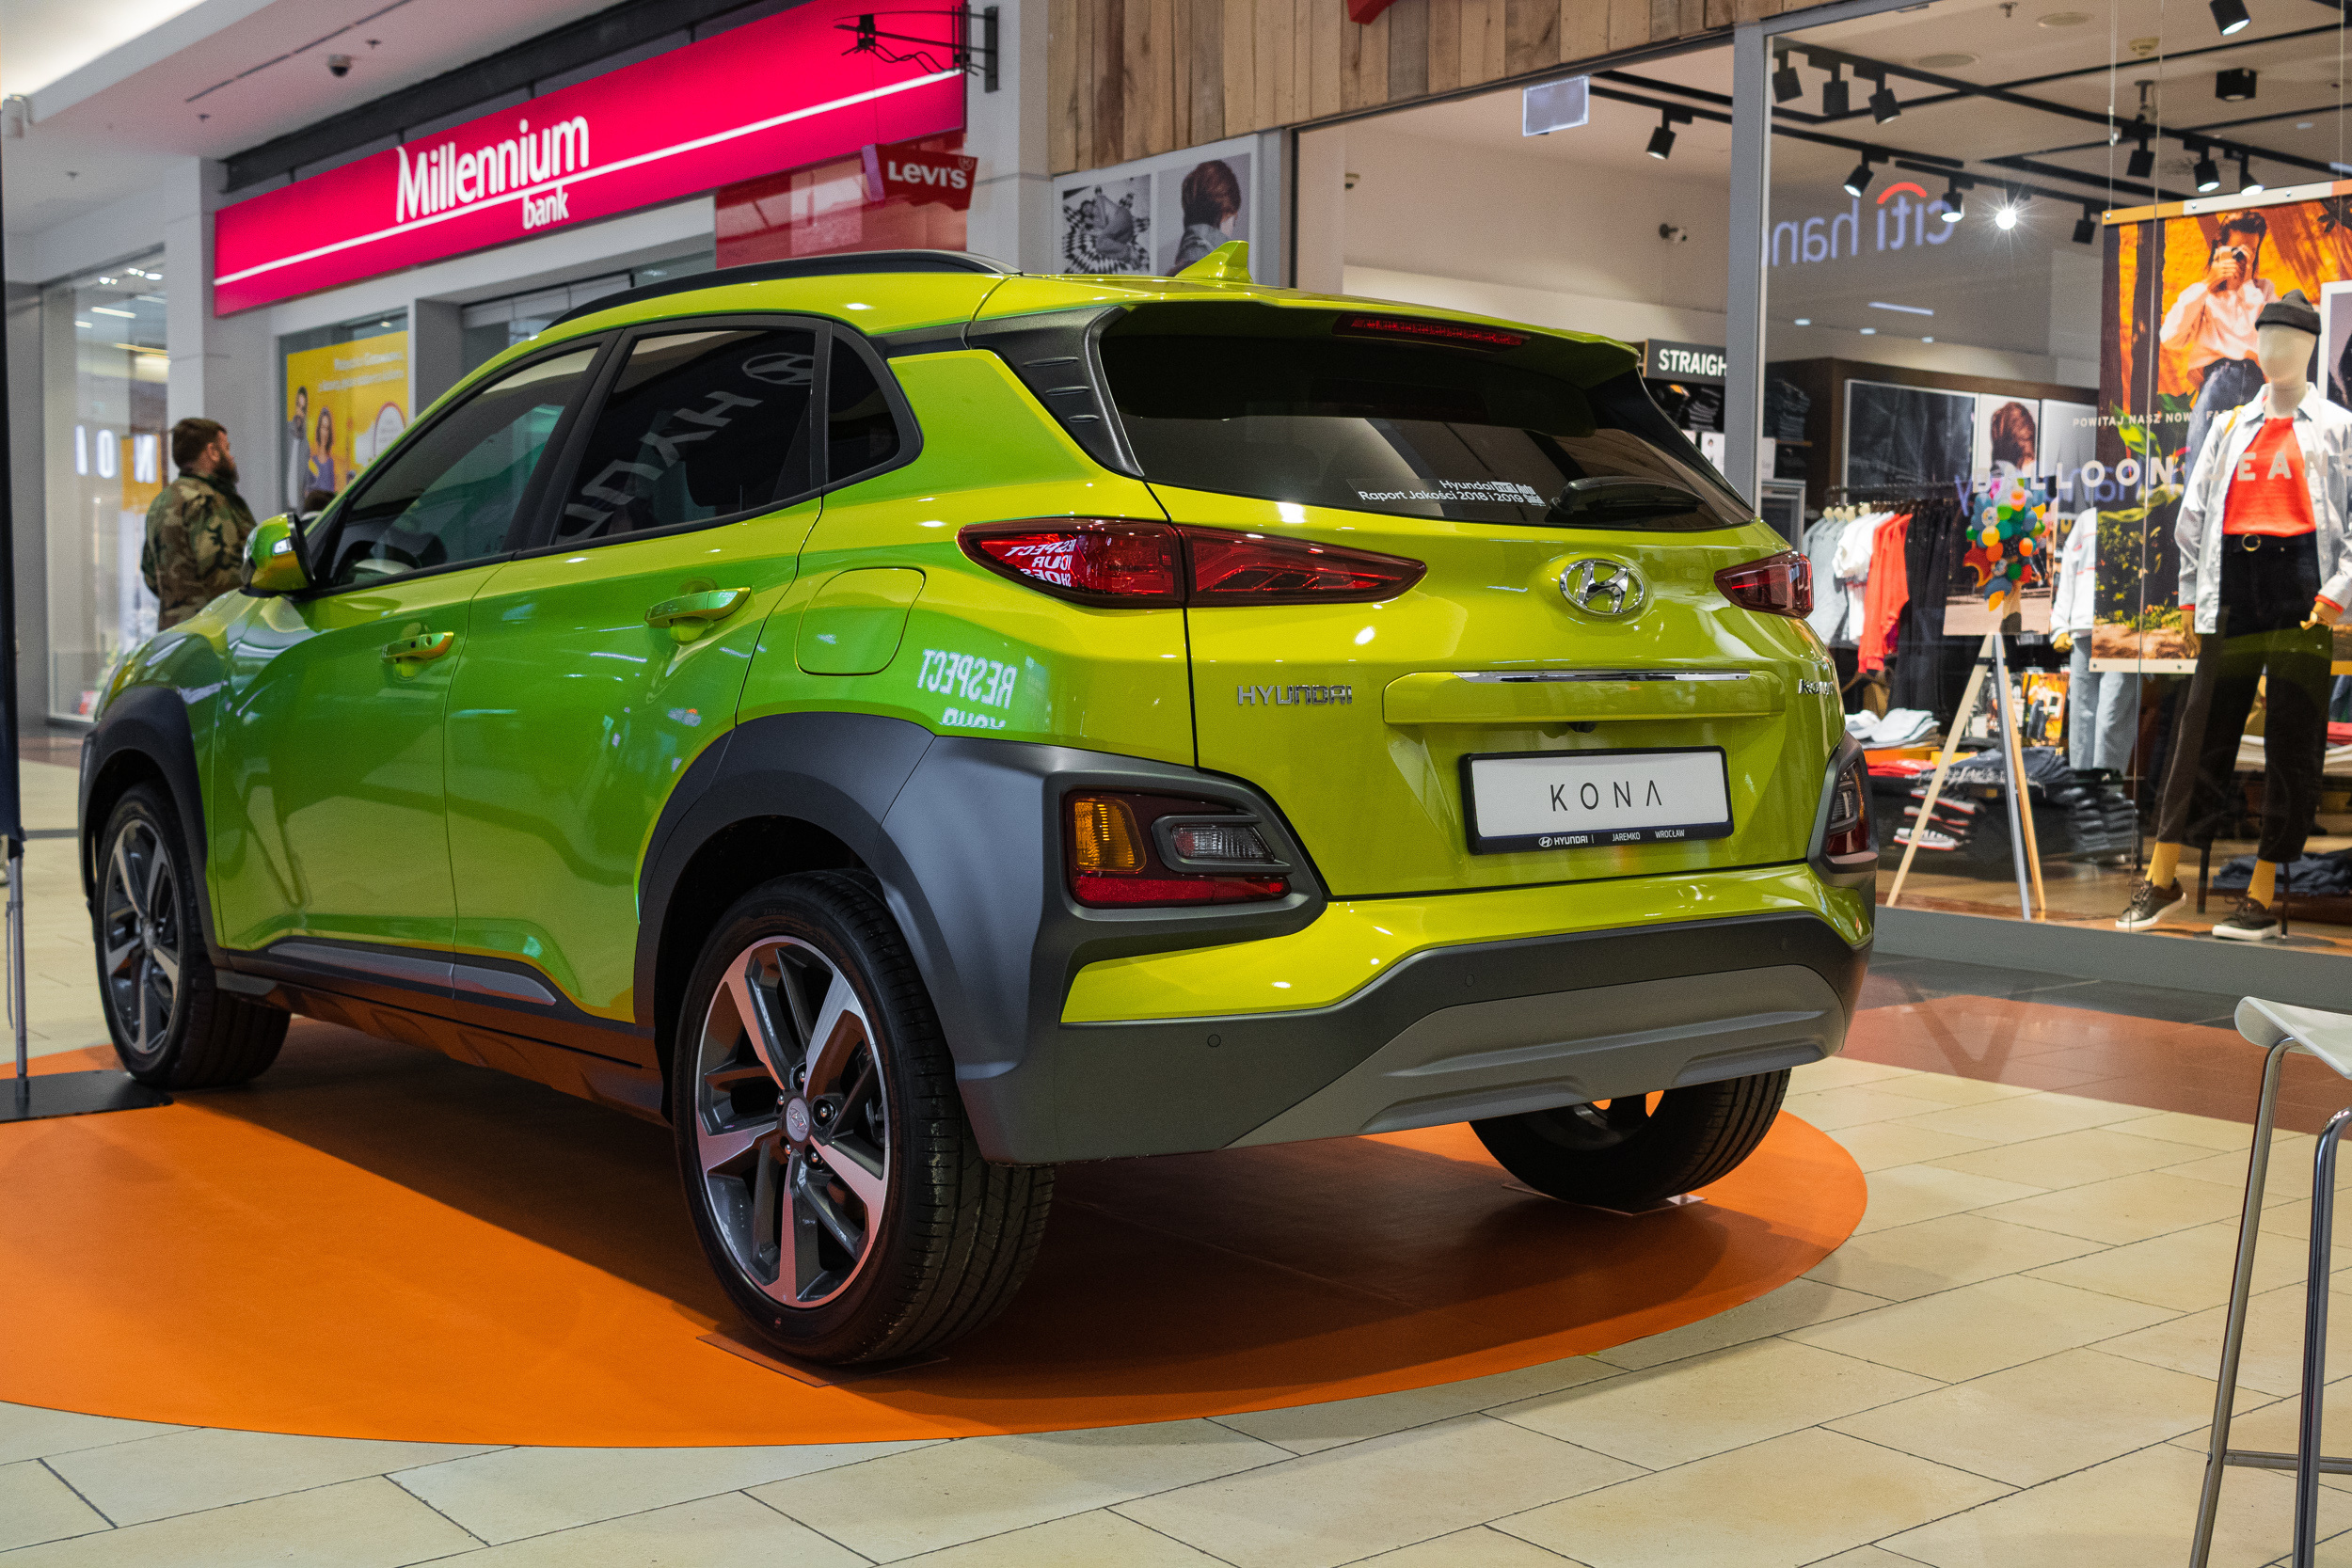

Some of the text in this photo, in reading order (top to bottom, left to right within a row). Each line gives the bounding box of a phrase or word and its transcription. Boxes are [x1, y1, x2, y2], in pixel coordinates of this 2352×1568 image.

[396, 115, 590, 224] Millennium
[522, 186, 570, 230] bank
[1658, 347, 1727, 377] STRAIGH
[2073, 414, 2124, 428] POWITAJ
[2128, 413, 2162, 425] NASZ
[1439, 480, 1494, 491] Hyundai
[1358, 489, 1526, 503] Raport Jakości 2018 i 2019
[1237, 684, 1353, 706] HYUNDAI
[1553, 829, 1685, 846] HYUNDAI JAREMKO WROCŁAW
